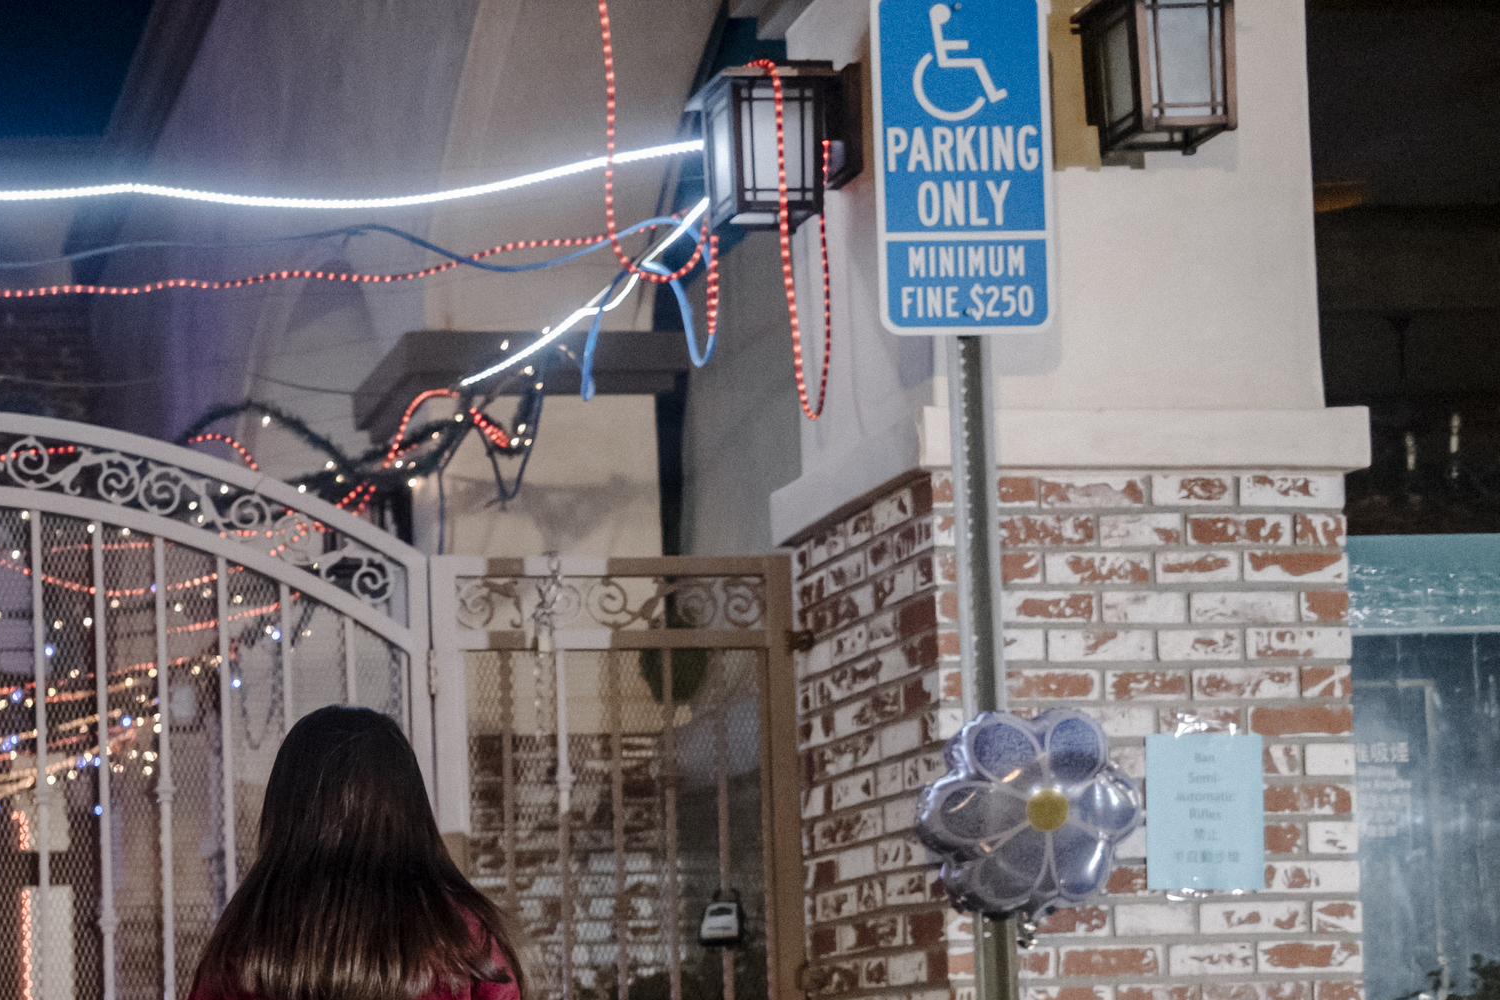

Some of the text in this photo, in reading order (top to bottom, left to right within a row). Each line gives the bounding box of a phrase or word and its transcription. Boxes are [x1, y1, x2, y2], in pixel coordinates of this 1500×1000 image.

[886, 125, 1040, 173] PARKING
[917, 180, 1011, 227] ONLY
[908, 245, 1025, 278] MINIMUM
[901, 283, 1034, 321] FINE $250
[1194, 752, 1215, 763] Ban
[1175, 791, 1235, 802] automatic
[1189, 808, 1221, 820] Rifles
